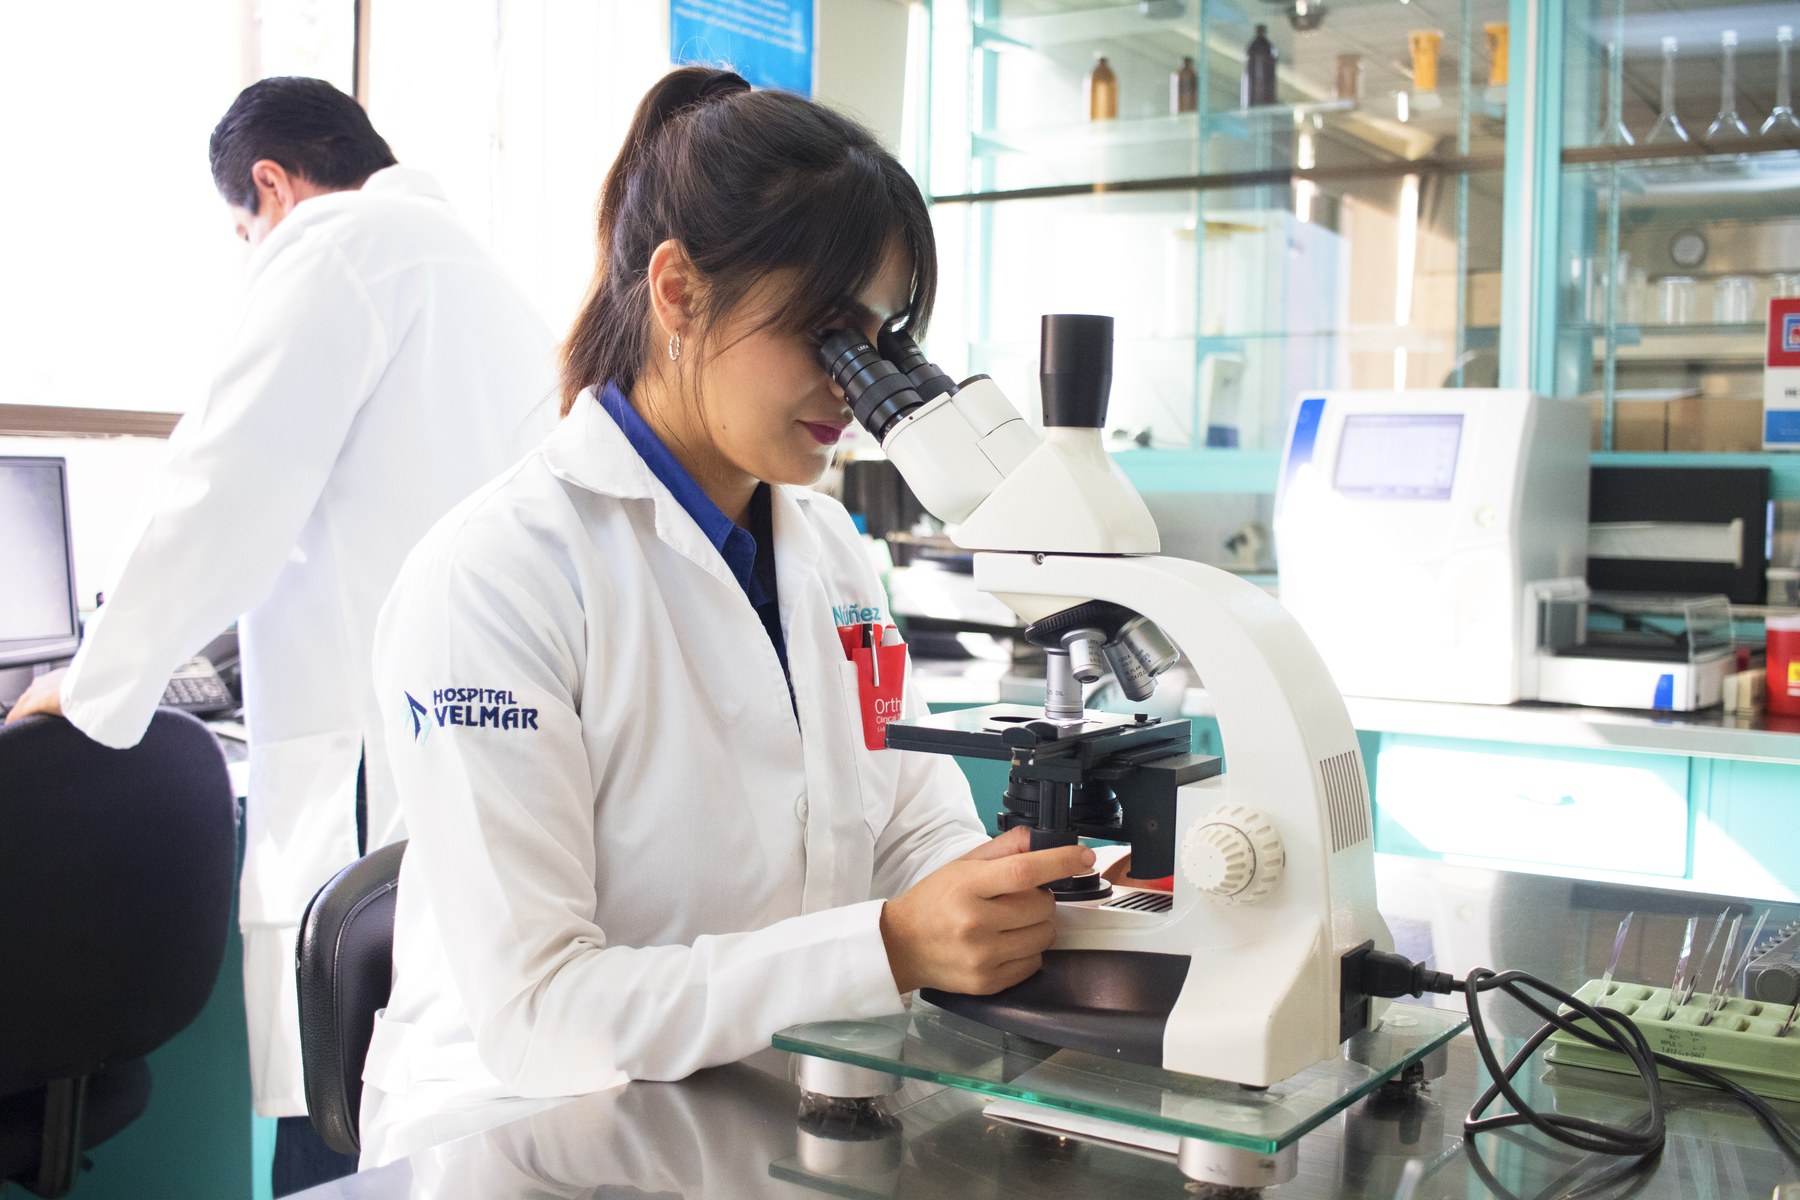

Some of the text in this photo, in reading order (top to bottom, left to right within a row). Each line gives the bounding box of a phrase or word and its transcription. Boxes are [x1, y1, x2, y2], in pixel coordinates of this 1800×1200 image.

[832, 604, 881, 626] Núñez
[433, 688, 517, 705] HOSPITAL
[434, 705, 538, 730] VELMAR
